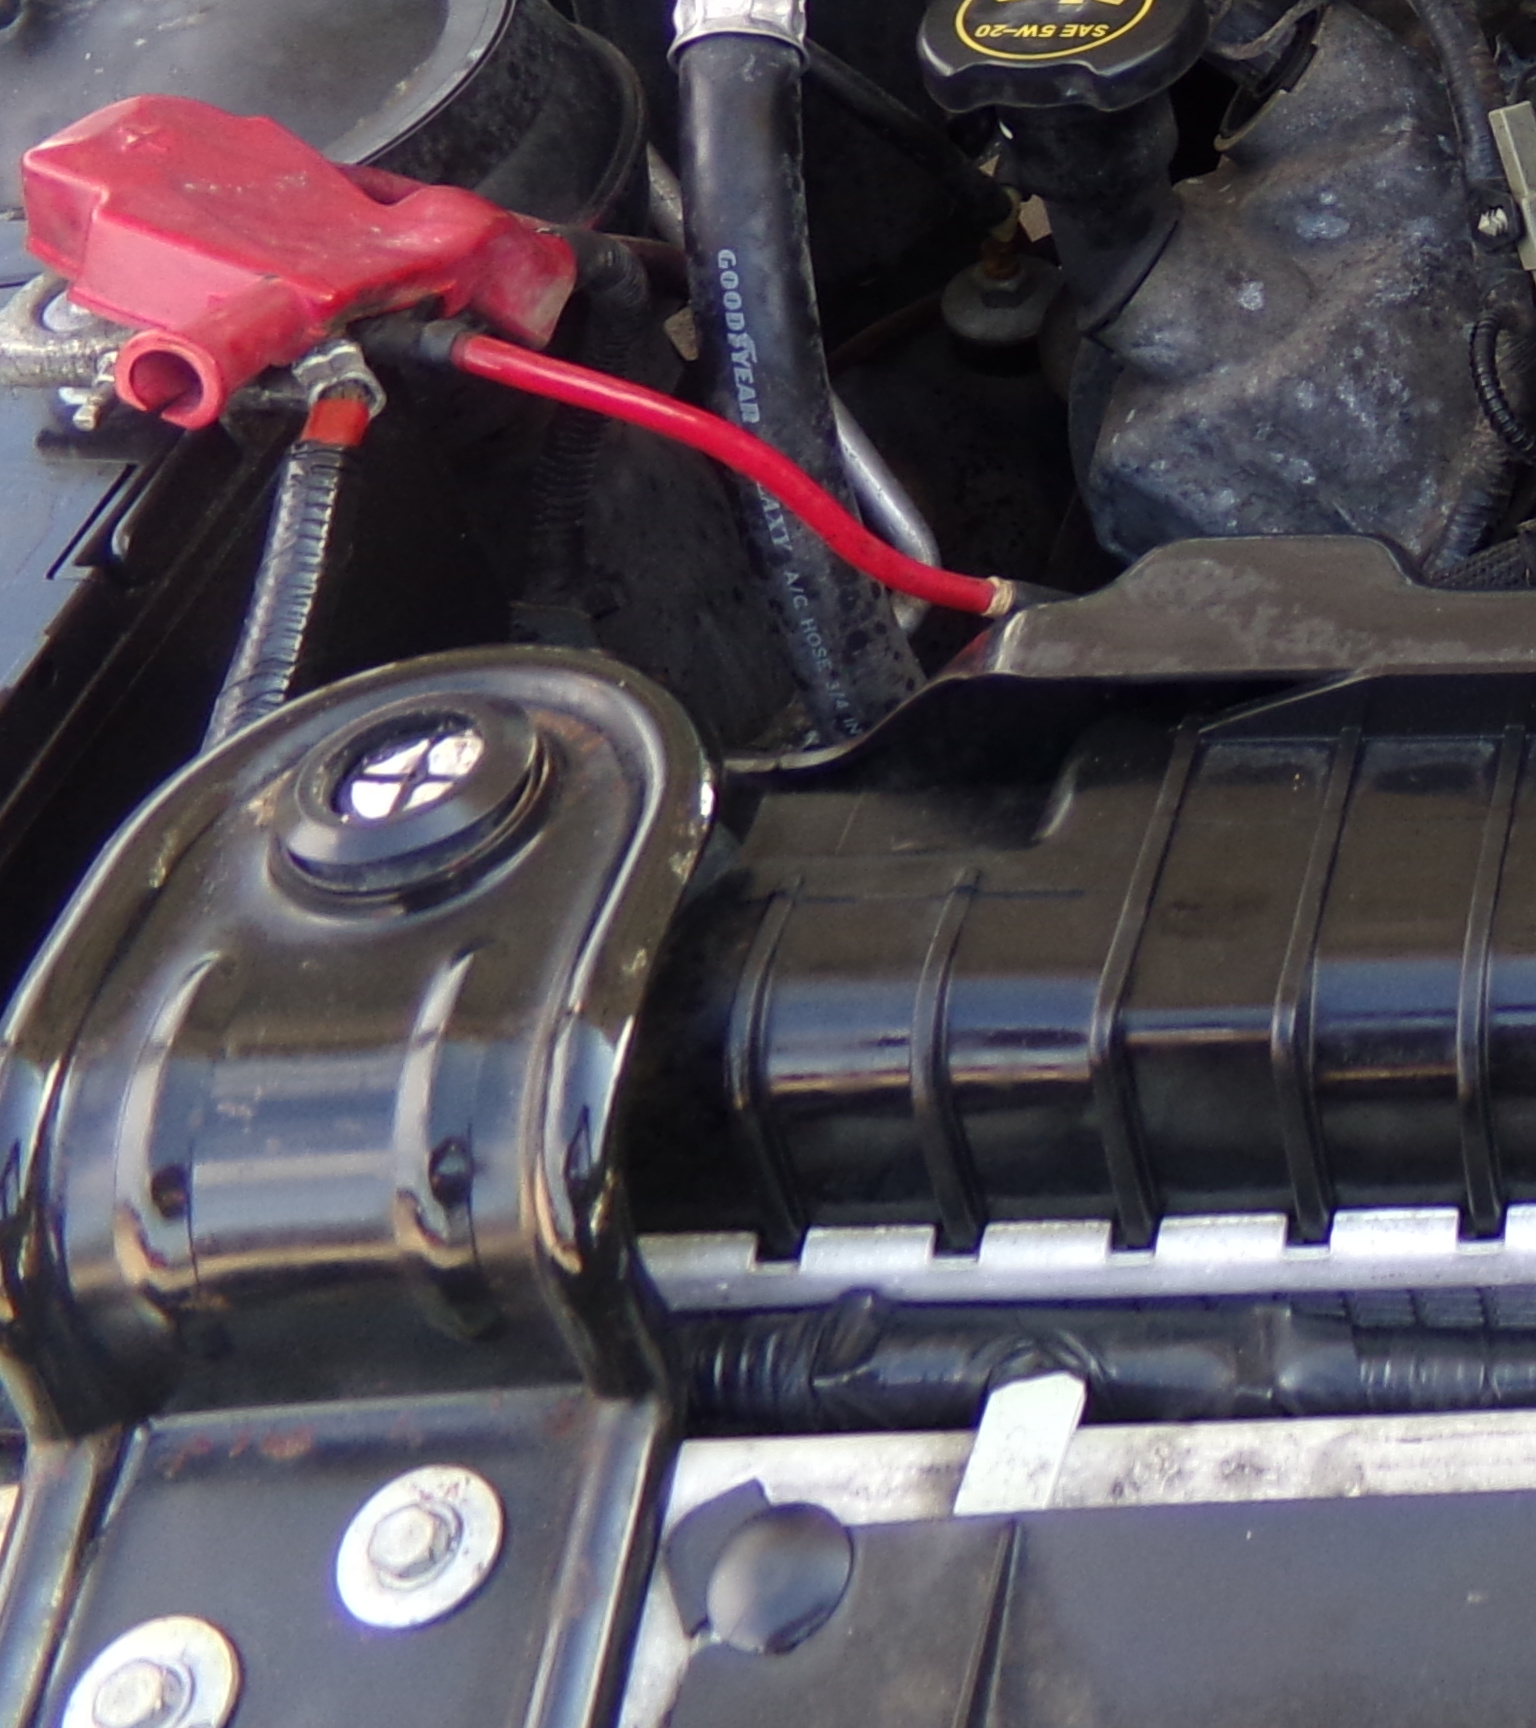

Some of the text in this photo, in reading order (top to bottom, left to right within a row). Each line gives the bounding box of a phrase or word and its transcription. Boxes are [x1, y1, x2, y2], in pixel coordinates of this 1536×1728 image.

[974, 22, 1110, 39] SAE 5W-20
[717, 248, 760, 425] GOODYEAR
[784, 571, 810, 610] A/C
[801, 617, 834, 670] HOSE
